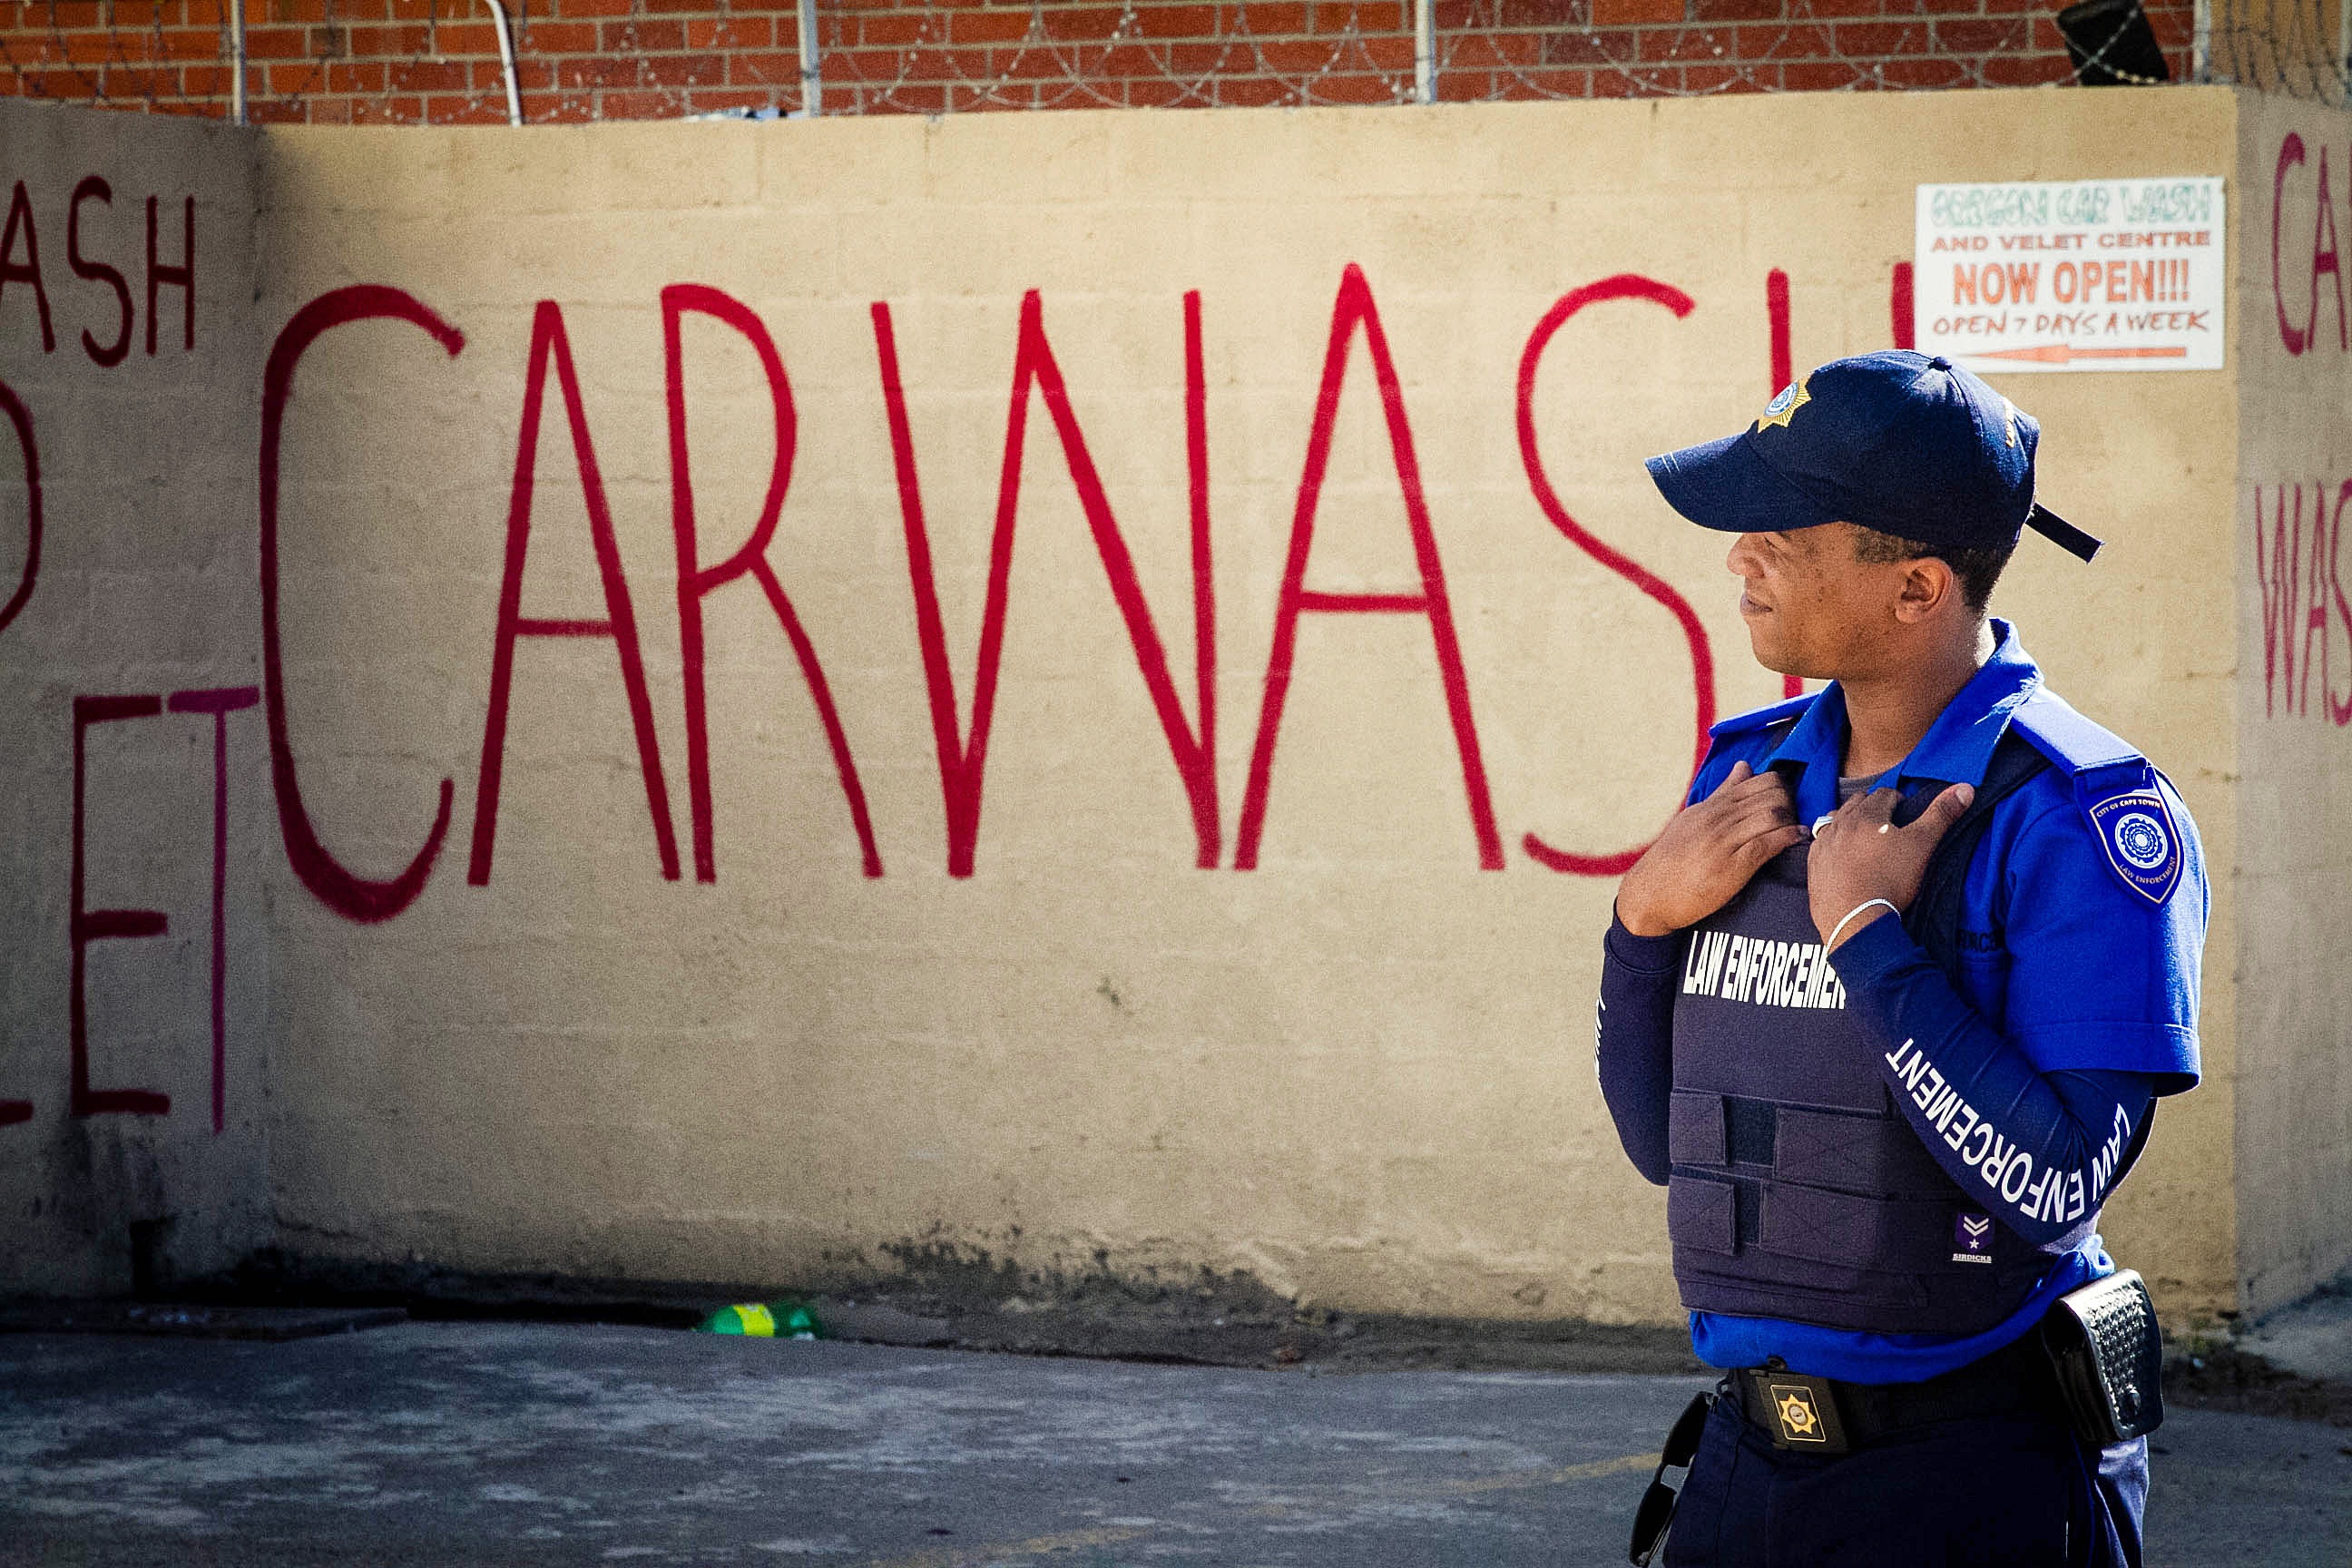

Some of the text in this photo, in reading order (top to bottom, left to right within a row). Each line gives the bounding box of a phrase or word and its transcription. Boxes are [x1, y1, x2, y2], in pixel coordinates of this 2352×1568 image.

[1932, 230, 2210, 252] AND VELET CENTRE
[2271, 132, 2352, 357] CA
[1953, 260, 2190, 306] NOW OPEN!!!
[1933, 309, 2211, 336] OPEN 7 DAYS A WEEK
[2096, 807, 2110, 818] CITY
[2138, 799, 2161, 809] TOWN
[2119, 856, 2176, 885] LAW ENFORCEMENT
[0, 684, 261, 1133] ET
[1683, 930, 1730, 996] LAW
[1885, 1037, 2132, 1223] LAW ENFORCEMENT
